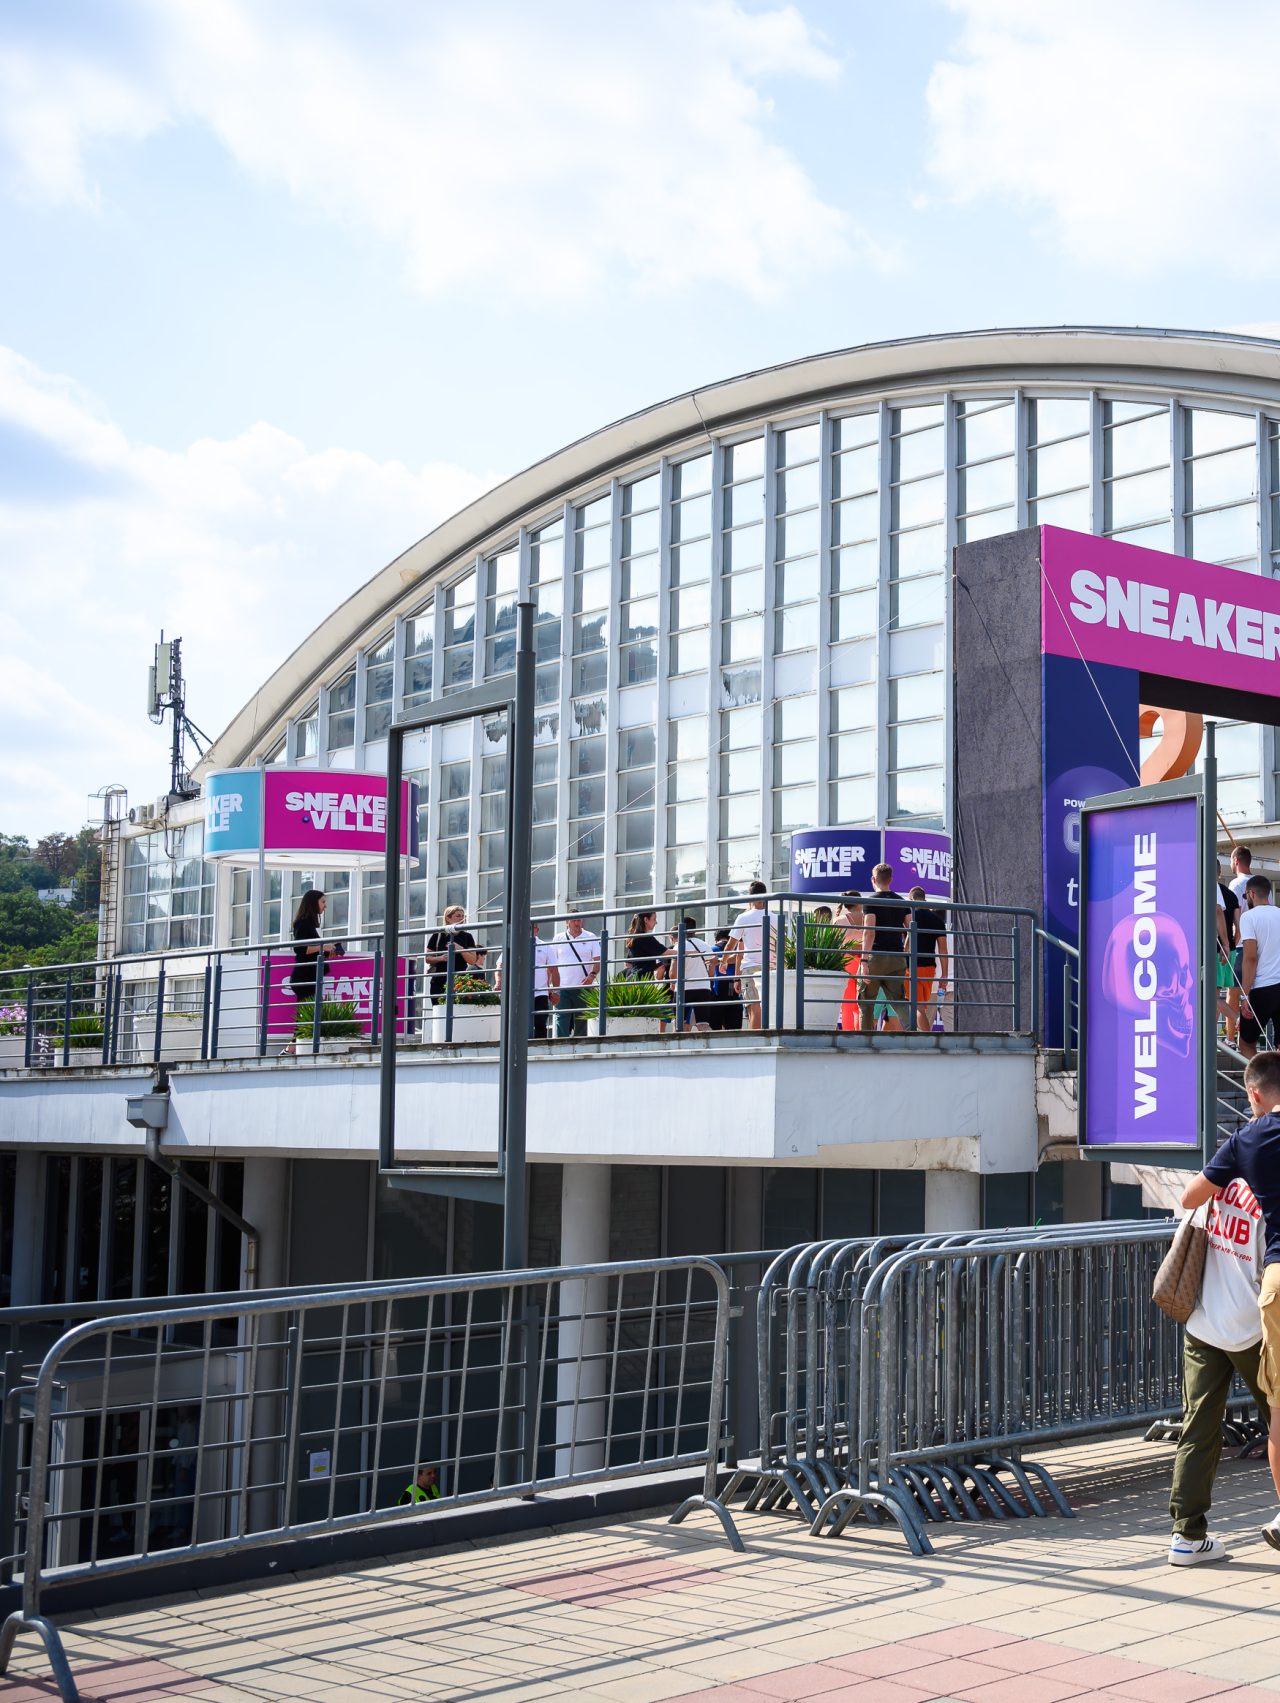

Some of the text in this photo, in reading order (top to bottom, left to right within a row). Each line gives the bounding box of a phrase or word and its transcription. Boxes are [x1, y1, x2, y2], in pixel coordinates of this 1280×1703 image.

[285, 791, 388, 814] SNEAKE
[309, 811, 387, 833] VILLE
[795, 846, 865, 864] SNEAKER
[900, 847, 952, 869] SNEAKE
[802, 861, 852, 879] VILLE
[1134, 832, 1158, 1119] WELCOME
